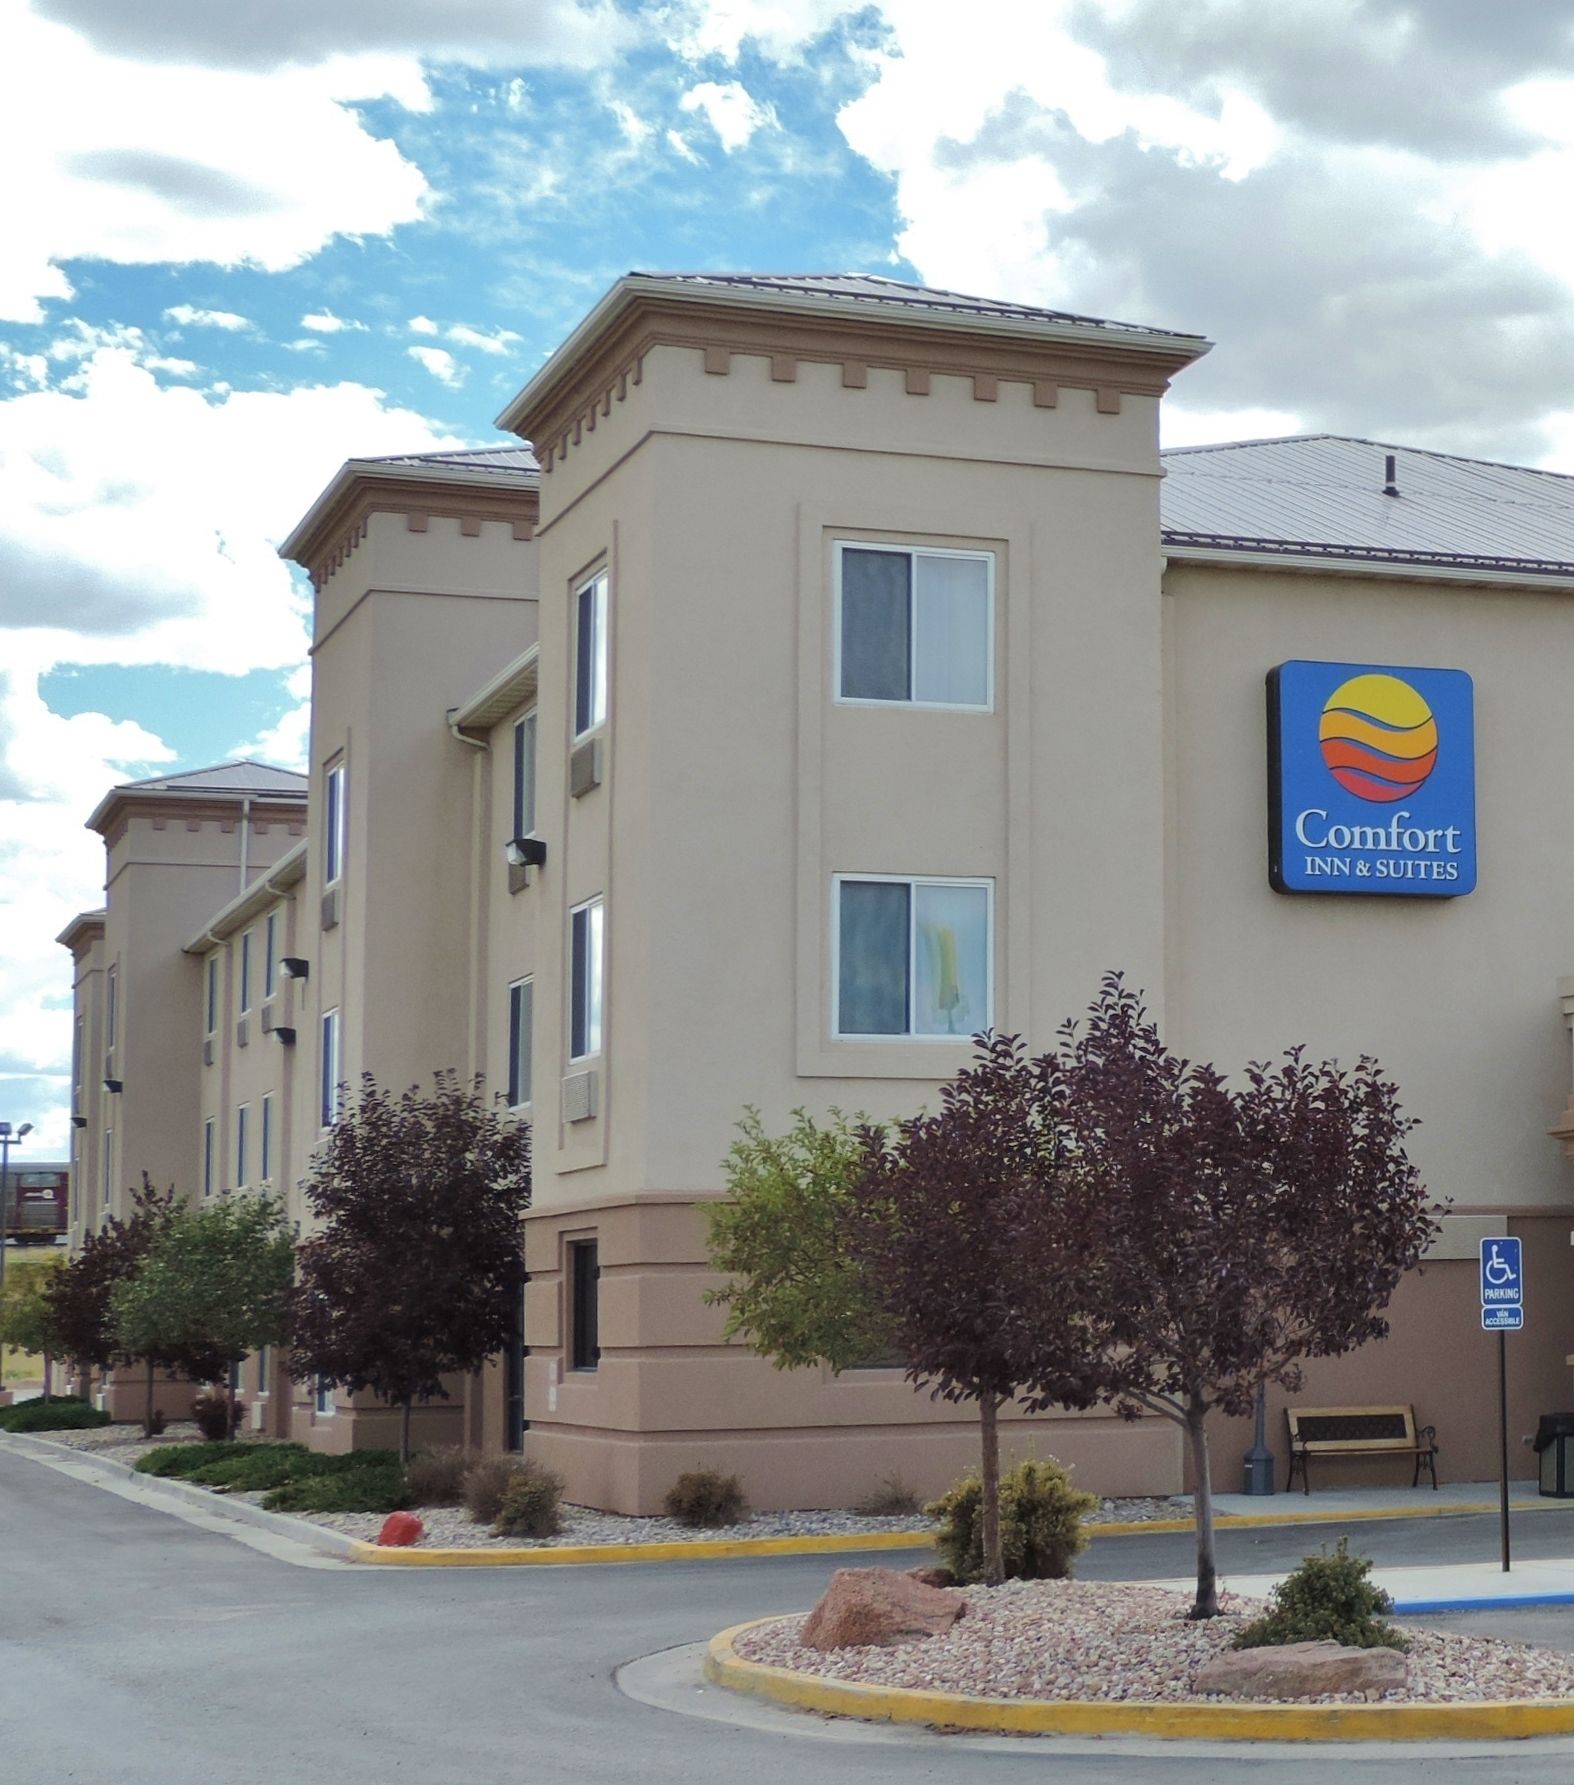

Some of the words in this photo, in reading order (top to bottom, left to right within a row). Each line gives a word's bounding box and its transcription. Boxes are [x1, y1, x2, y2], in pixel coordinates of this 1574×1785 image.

[1295, 808, 1462, 853] Comfort
[1305, 856, 1351, 877] INN
[1355, 860, 1372, 877] &
[1376, 858, 1459, 881] SUITES
[1484, 1287, 1519, 1300] PARKING
[1496, 1310, 1509, 1318] VAN
[1485, 1317, 1520, 1325] ACCESSIBLE
